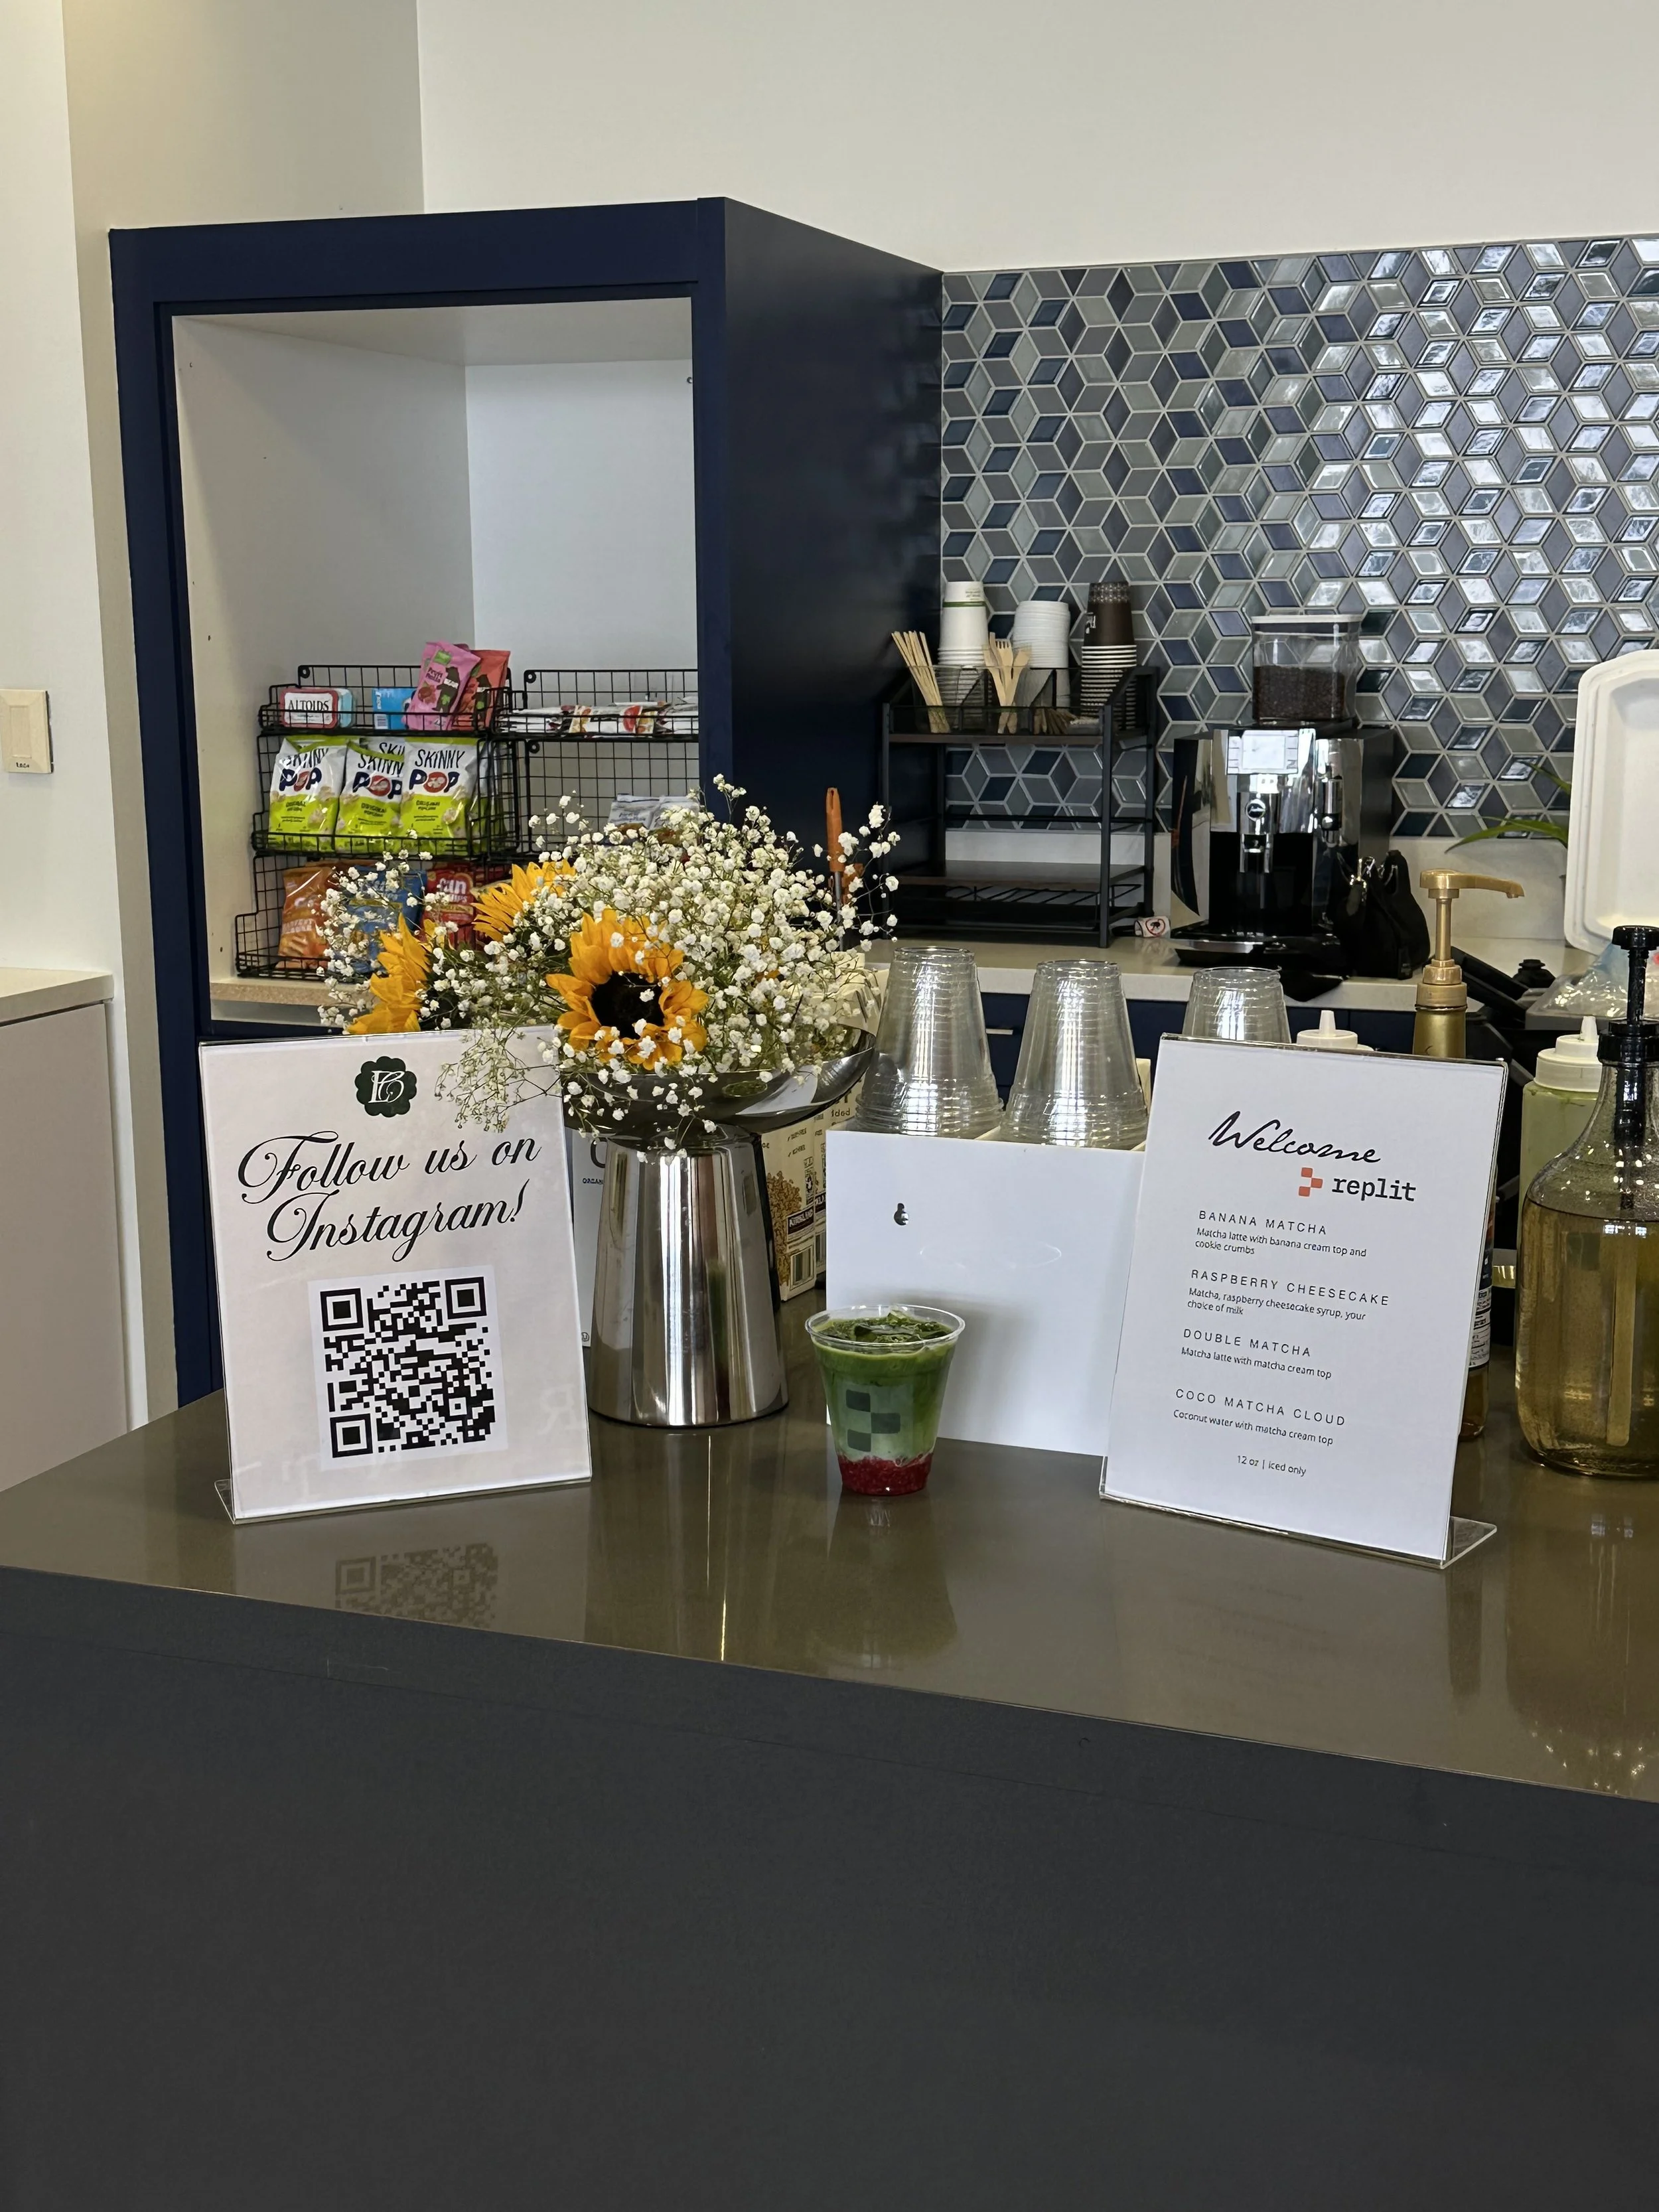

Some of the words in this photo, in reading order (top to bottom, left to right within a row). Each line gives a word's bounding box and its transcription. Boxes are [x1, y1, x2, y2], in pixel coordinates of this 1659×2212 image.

[288, 700, 330, 711] ALTOIDS
[415, 749, 465, 769] SKINNY
[409, 769, 461, 793] POP
[1208, 1110, 1381, 1163] Welcome
[238, 1130, 411, 1205] Follow
[423, 1140, 478, 1175] us
[491, 1138, 542, 1166] on
[1331, 1177, 1417, 1202] replit
[266, 1178, 530, 1262] Instagram!
[1199, 1211, 1257, 1226] BANANA
[1265, 1219, 1327, 1235] MATCHA
[1195, 1240, 1222, 1251] cookie
[1224, 1244, 1255, 1254] crumbs
[1196, 1228, 1227, 1239] Matcha
[1229, 1231, 1248, 1242] latte
[1250, 1234, 1267, 1244] with
[1269, 1236, 1301, 1248] banana
[1303, 1242, 1331, 1253] cream
[1333, 1246, 1348, 1256] top
[1350, 1248, 1367, 1257] and
[1191, 1269, 1279, 1290] RASPBERRY
[1287, 1282, 1389, 1305] CHEESECAKE
[1187, 1299, 1214, 1311] choice
[1215, 1303, 1225, 1313] of
[1226, 1305, 1244, 1315] milk
[1189, 1288, 1221, 1301] Matcha,
[1223, 1293, 1264, 1308] raspberry
[1266, 1298, 1315, 1314] cheesecake
[1345, 1311, 1366, 1321] your
[1183, 1329, 1241, 1347] DOUBLE
[1250, 1339, 1311, 1357] MATCHA
[1181, 1347, 1211, 1359] Matcha
[1213, 1351, 1232, 1363] latte
[1234, 1356, 1252, 1366] with
[1254, 1360, 1285, 1372] matcha
[1287, 1364, 1315, 1376] cream
[1317, 1369, 1332, 1380] top
[1175, 1388, 1216, 1404] COCO
[1224, 1396, 1285, 1416] MATCHA
[1293, 1408, 1345, 1426] CLOUD
[1173, 1409, 1208, 1424] Coconut
[1209, 1416, 1233, 1428] water
[1235, 1420, 1253, 1431] with
[1255, 1424, 1287, 1437] matcha
[1289, 1430, 1316, 1442] cream
[1319, 1434, 1333, 1446] top
[1237, 1455, 1247, 1465] 12
[1249, 1458, 1260, 1467] oz
[1268, 1460, 1286, 1471] iced
[1287, 1465, 1307, 1477] only
